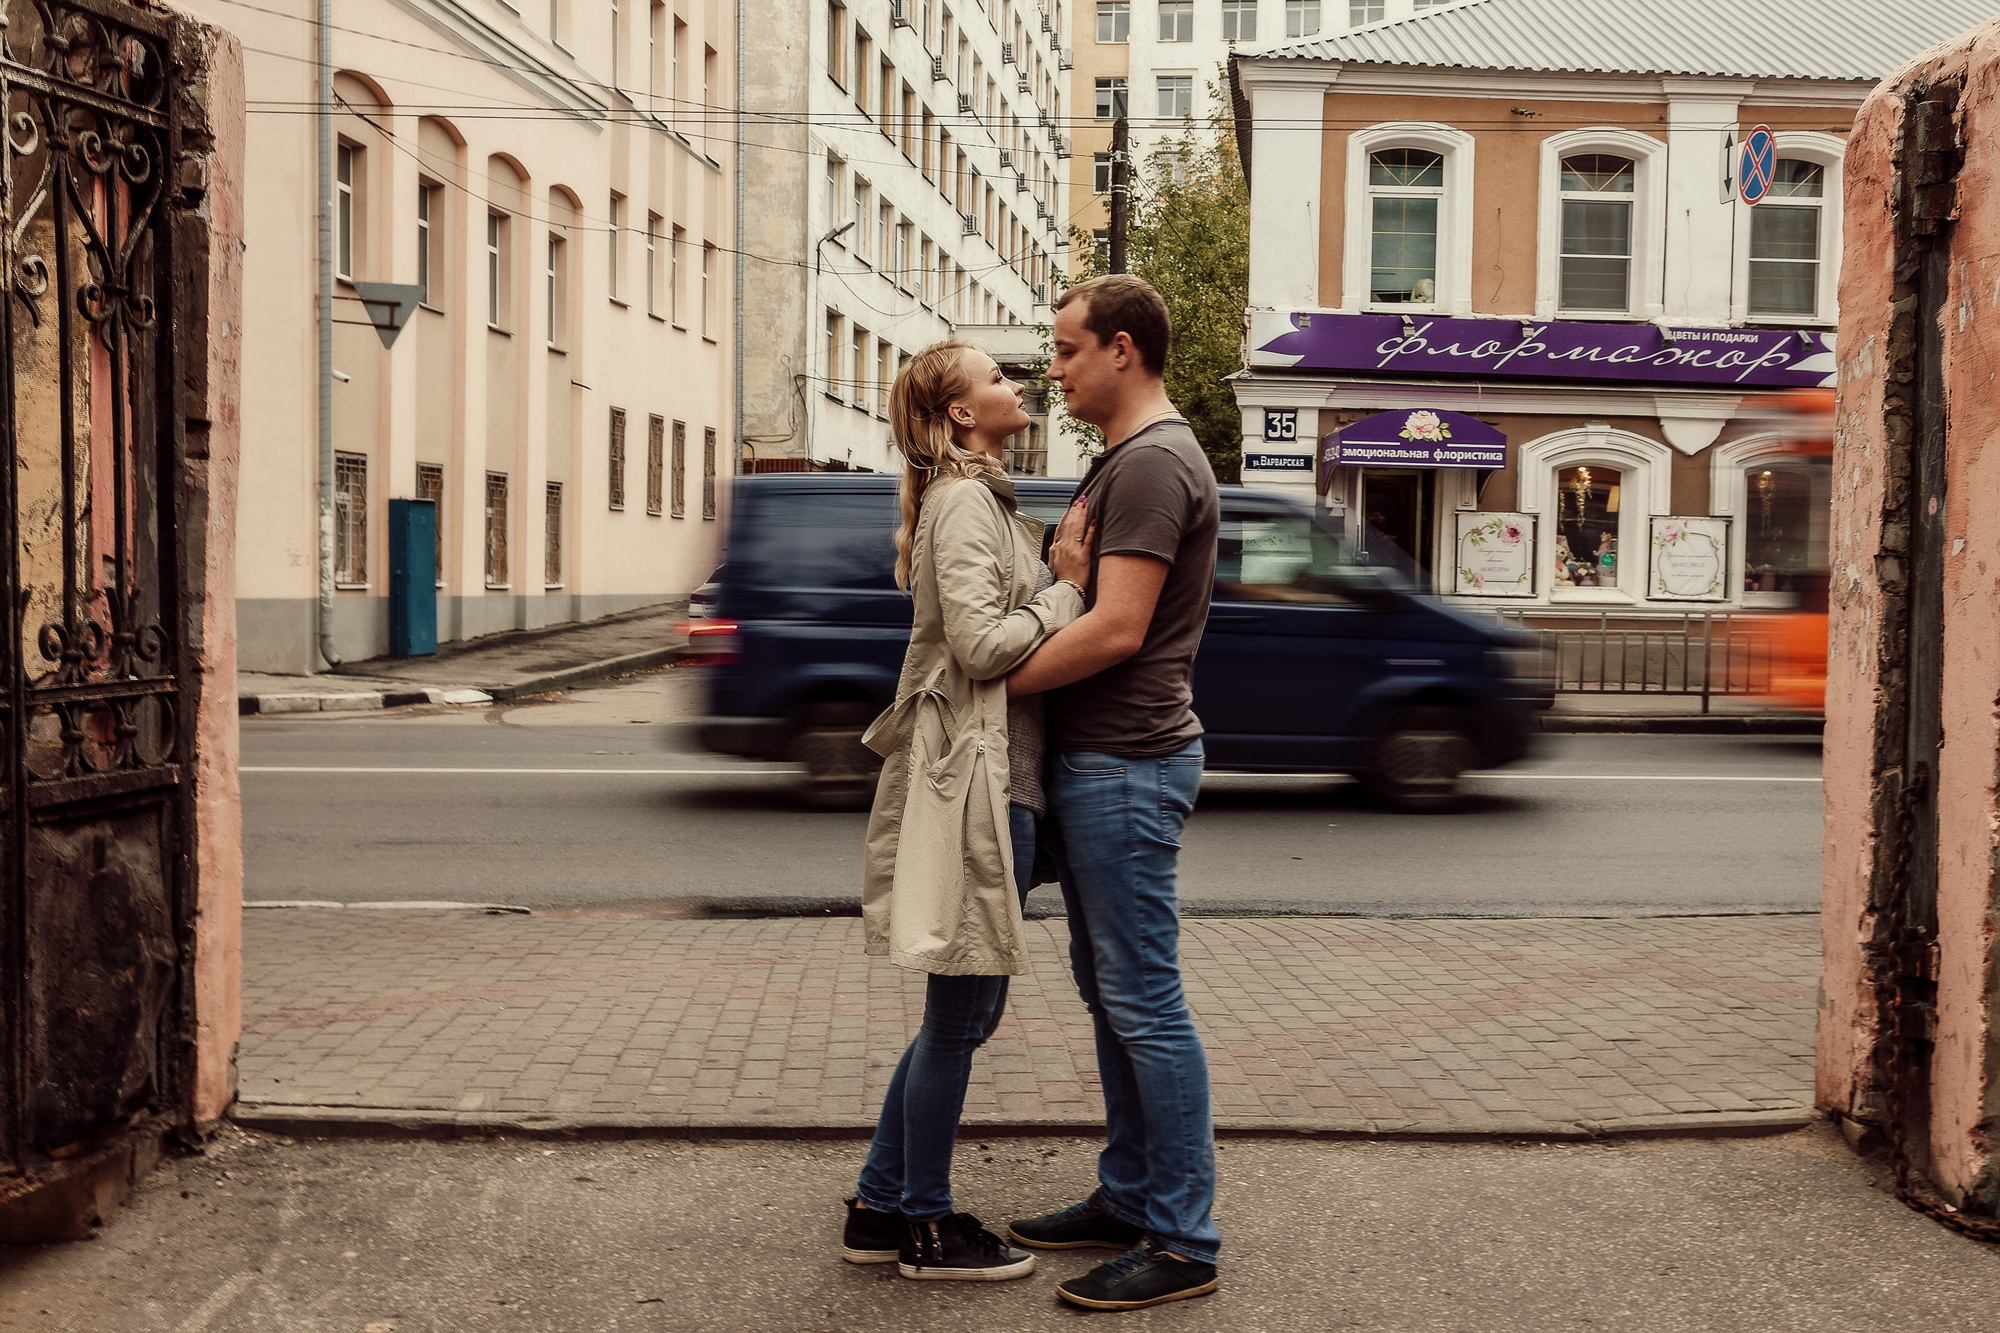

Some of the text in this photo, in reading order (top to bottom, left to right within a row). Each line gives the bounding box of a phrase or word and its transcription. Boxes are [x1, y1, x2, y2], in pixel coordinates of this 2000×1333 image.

[1702, 332, 1711, 341] И
[1711, 332, 1759, 344] ПОДАРКИ
[1267, 412, 1296, 438] 35
[1341, 447, 1430, 459] эмоциональная
[1433, 448, 1503, 462] флористика
